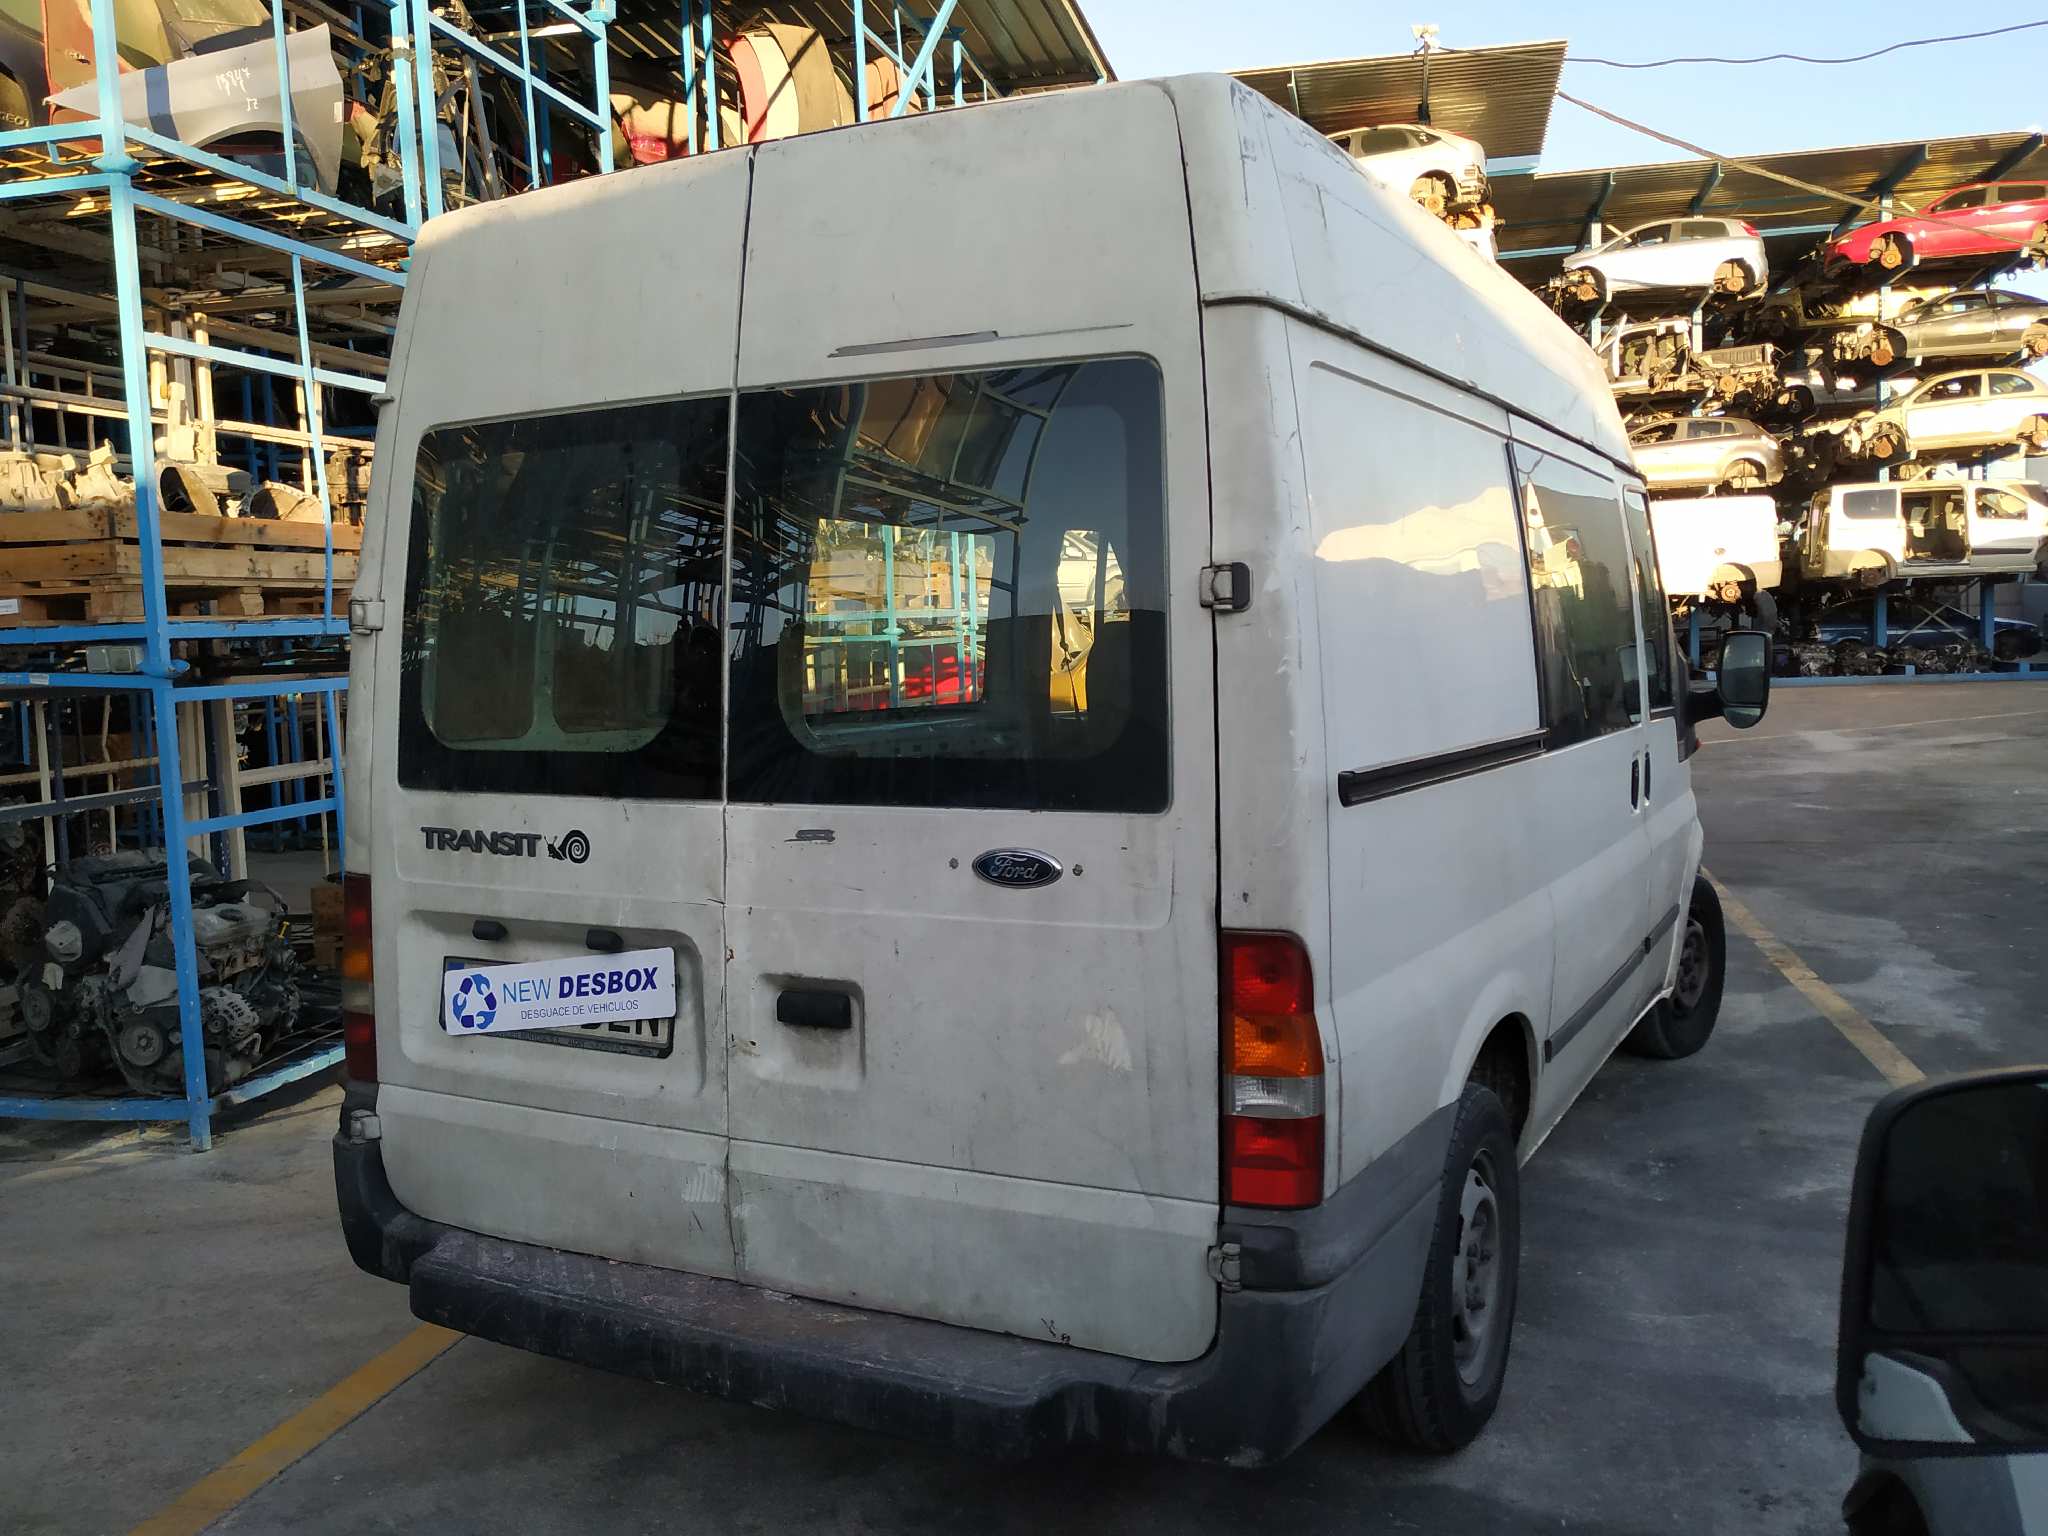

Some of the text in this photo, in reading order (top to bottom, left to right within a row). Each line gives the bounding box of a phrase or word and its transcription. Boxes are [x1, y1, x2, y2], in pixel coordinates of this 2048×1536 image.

[420, 826, 542, 857] TRANSIT
[989, 855, 1040, 880] Ford
[502, 967, 658, 1004] NEW DESBOX
[520, 1000, 639, 1020] DESGUACE DE VEHICULOS
